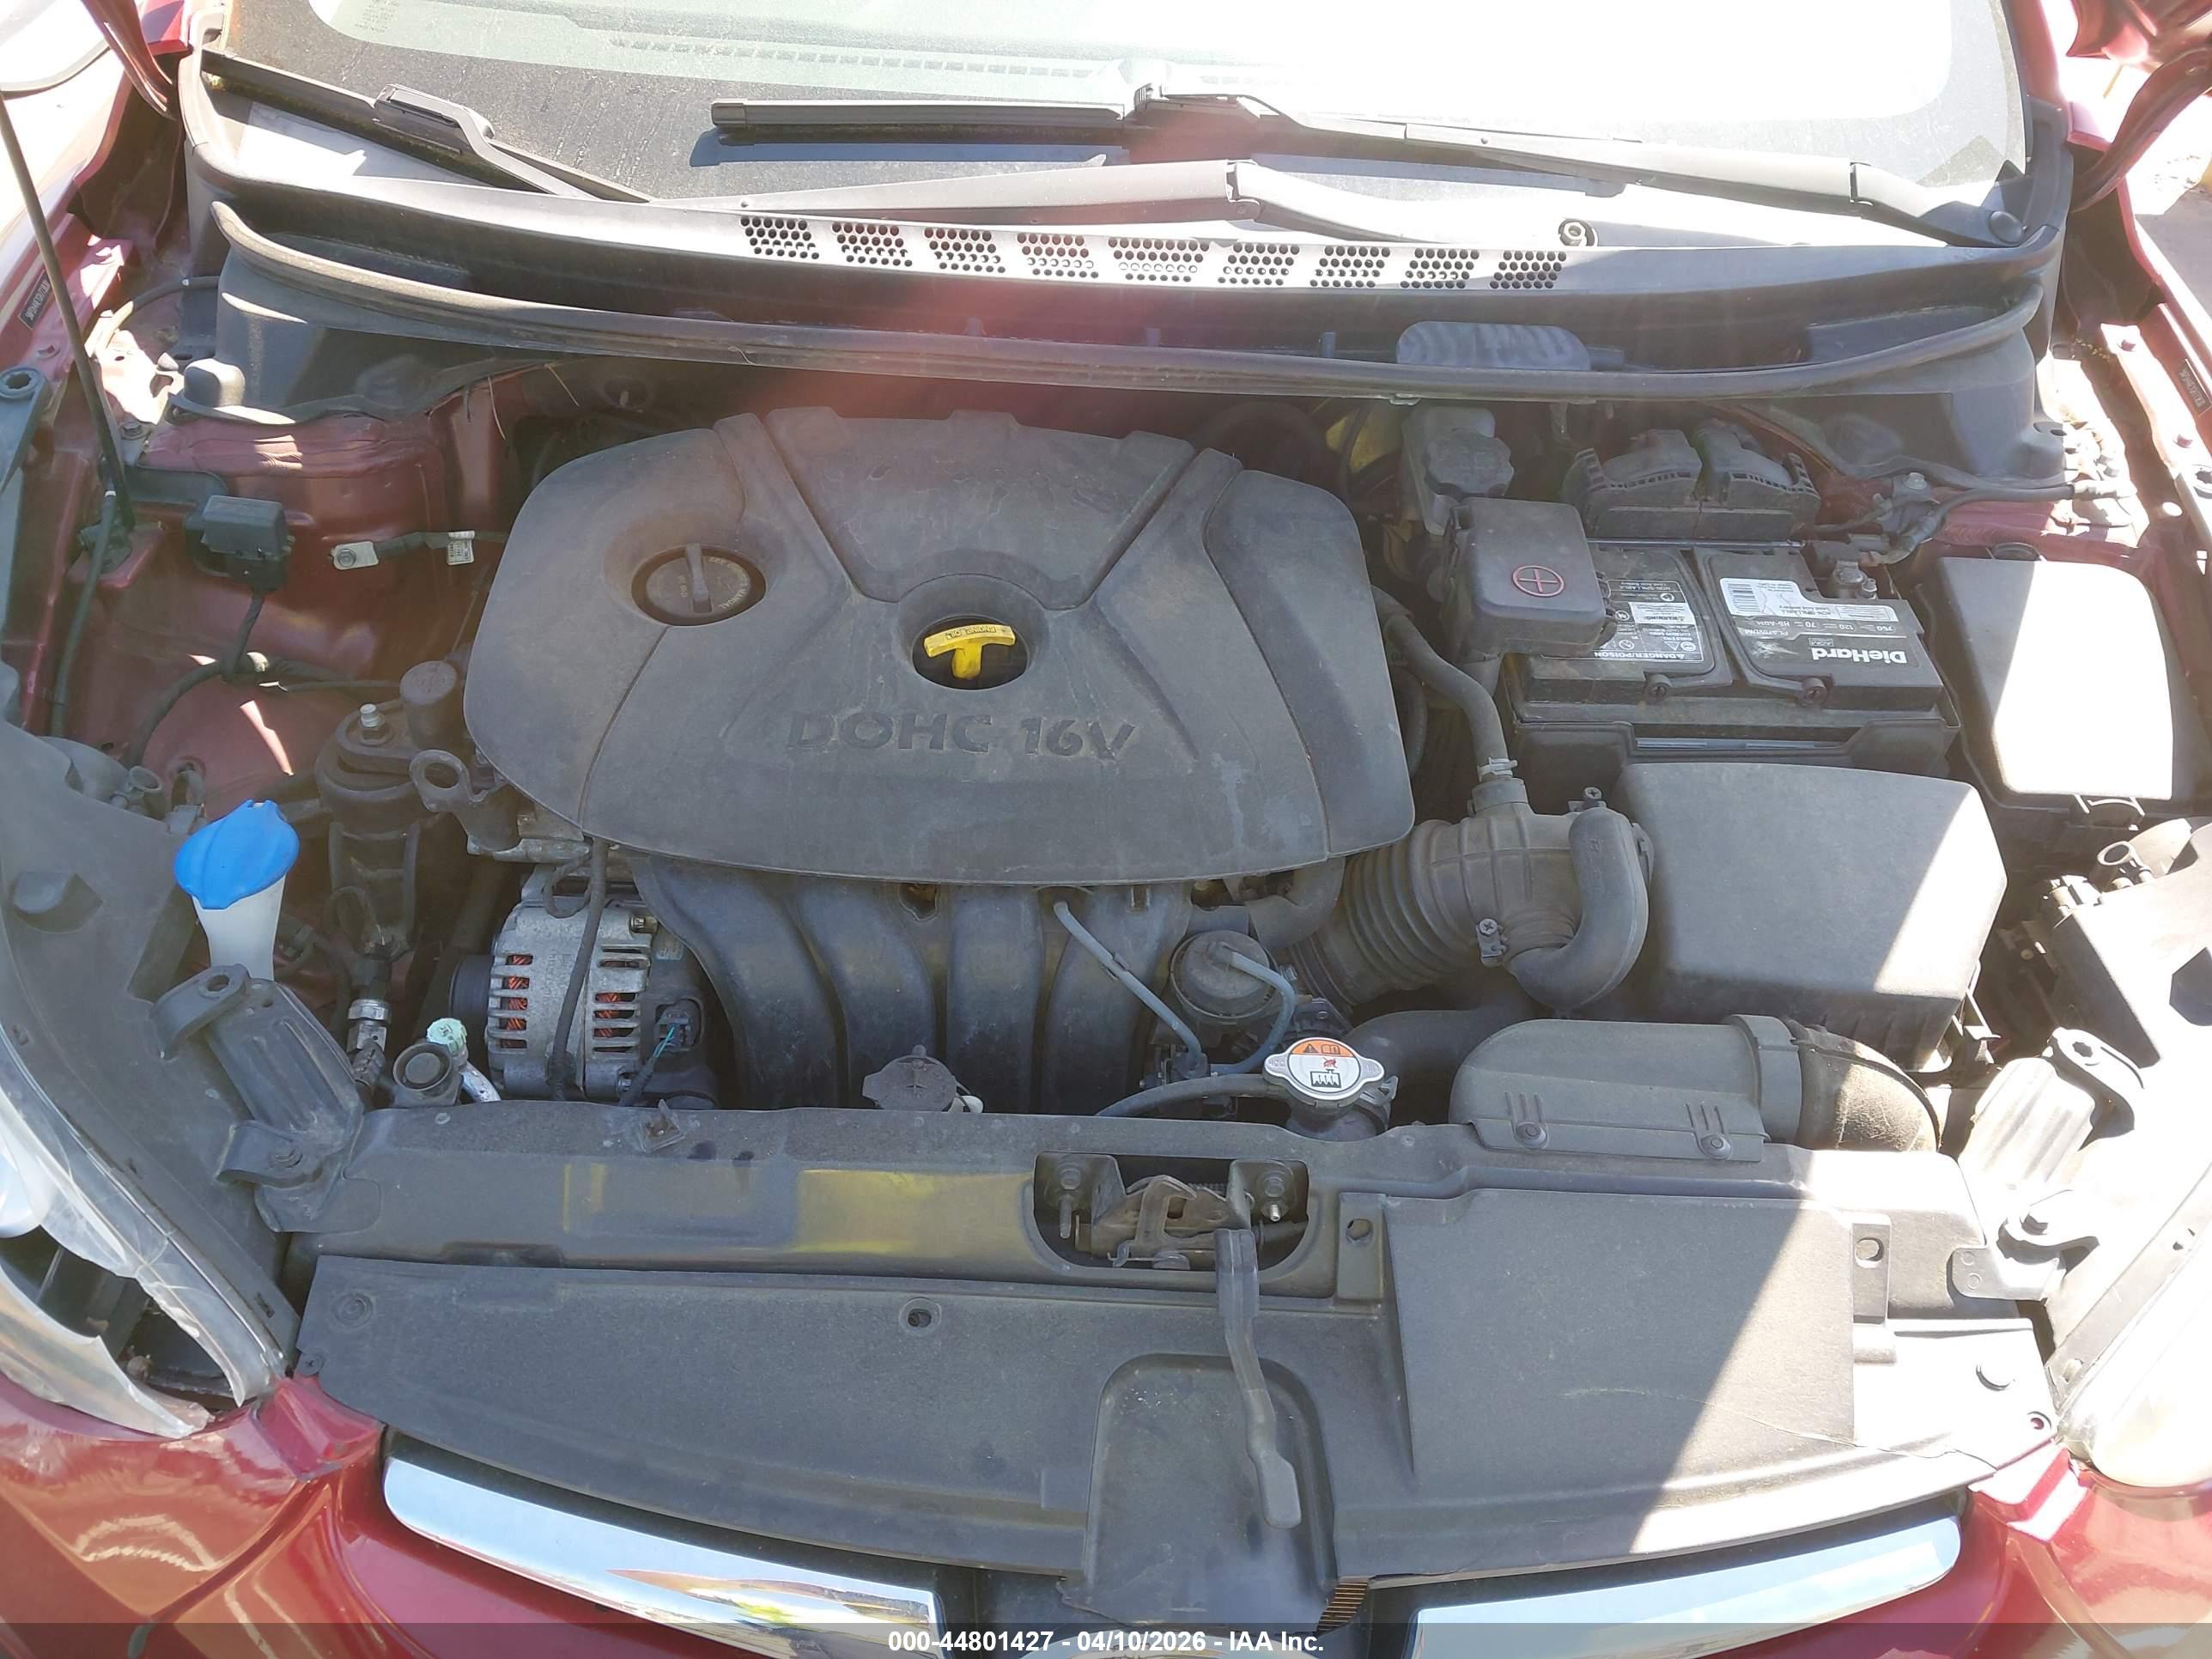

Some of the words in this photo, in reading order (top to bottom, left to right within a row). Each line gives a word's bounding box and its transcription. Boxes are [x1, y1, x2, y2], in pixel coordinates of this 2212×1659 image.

[1594, 651, 1679, 659] DANGER/POISON
[1811, 647, 1908, 665] DieHard
[788, 712, 993, 754] DOHC
[1021, 716, 1134, 760] 16V
